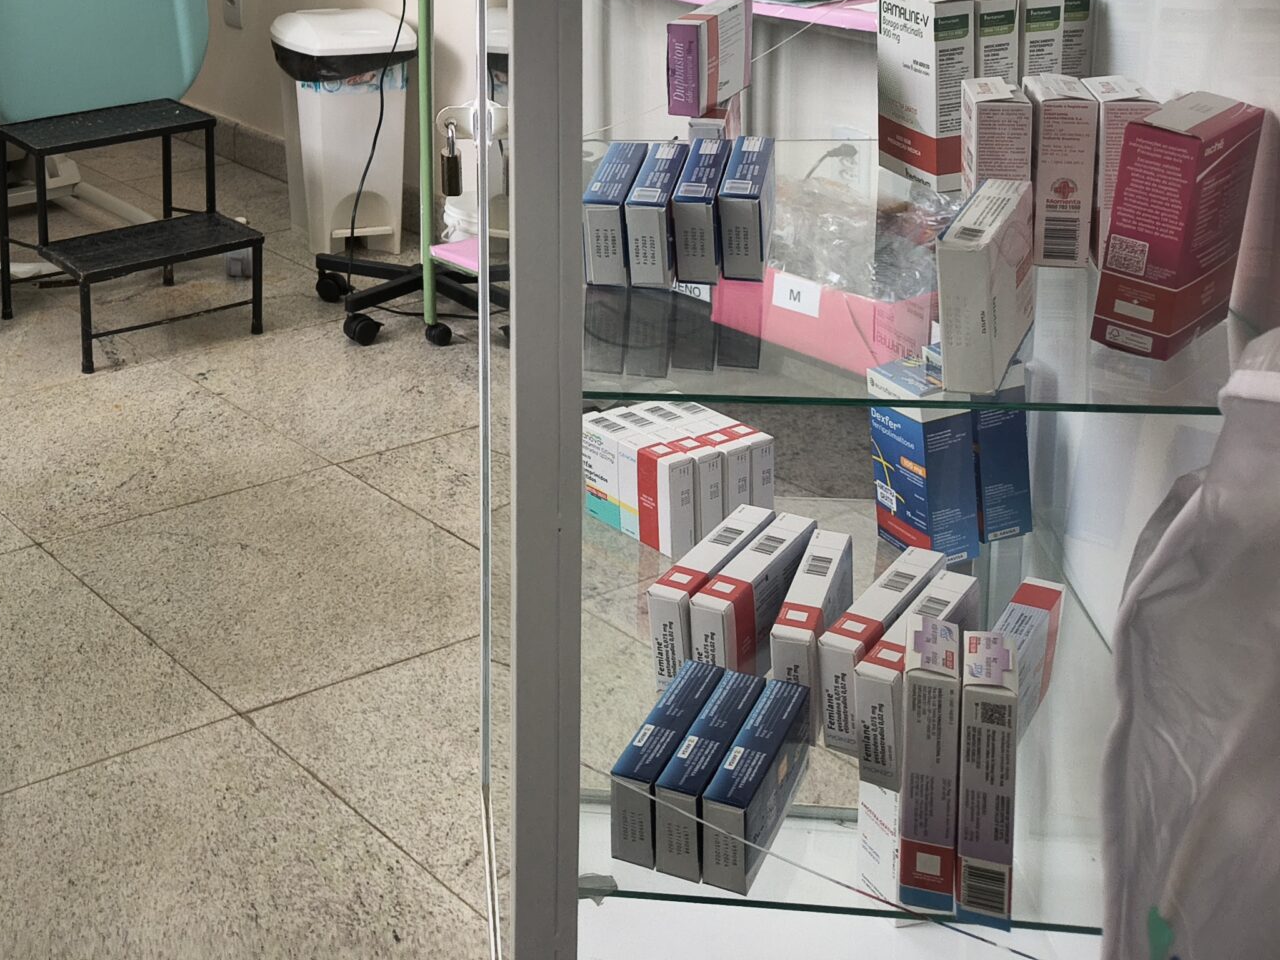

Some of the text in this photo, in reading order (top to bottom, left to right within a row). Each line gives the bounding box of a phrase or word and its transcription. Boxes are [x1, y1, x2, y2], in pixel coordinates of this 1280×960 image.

[883, 16, 923, 38] Borago officinalis
[892, 33, 900, 44] mg
[674, 42, 685, 102] Duphaston
[789, 288, 801, 303] M
[656, 641, 665, 676] Femiane
[827, 693, 835, 730] Femiane
[863, 724, 872, 762] Femiane
